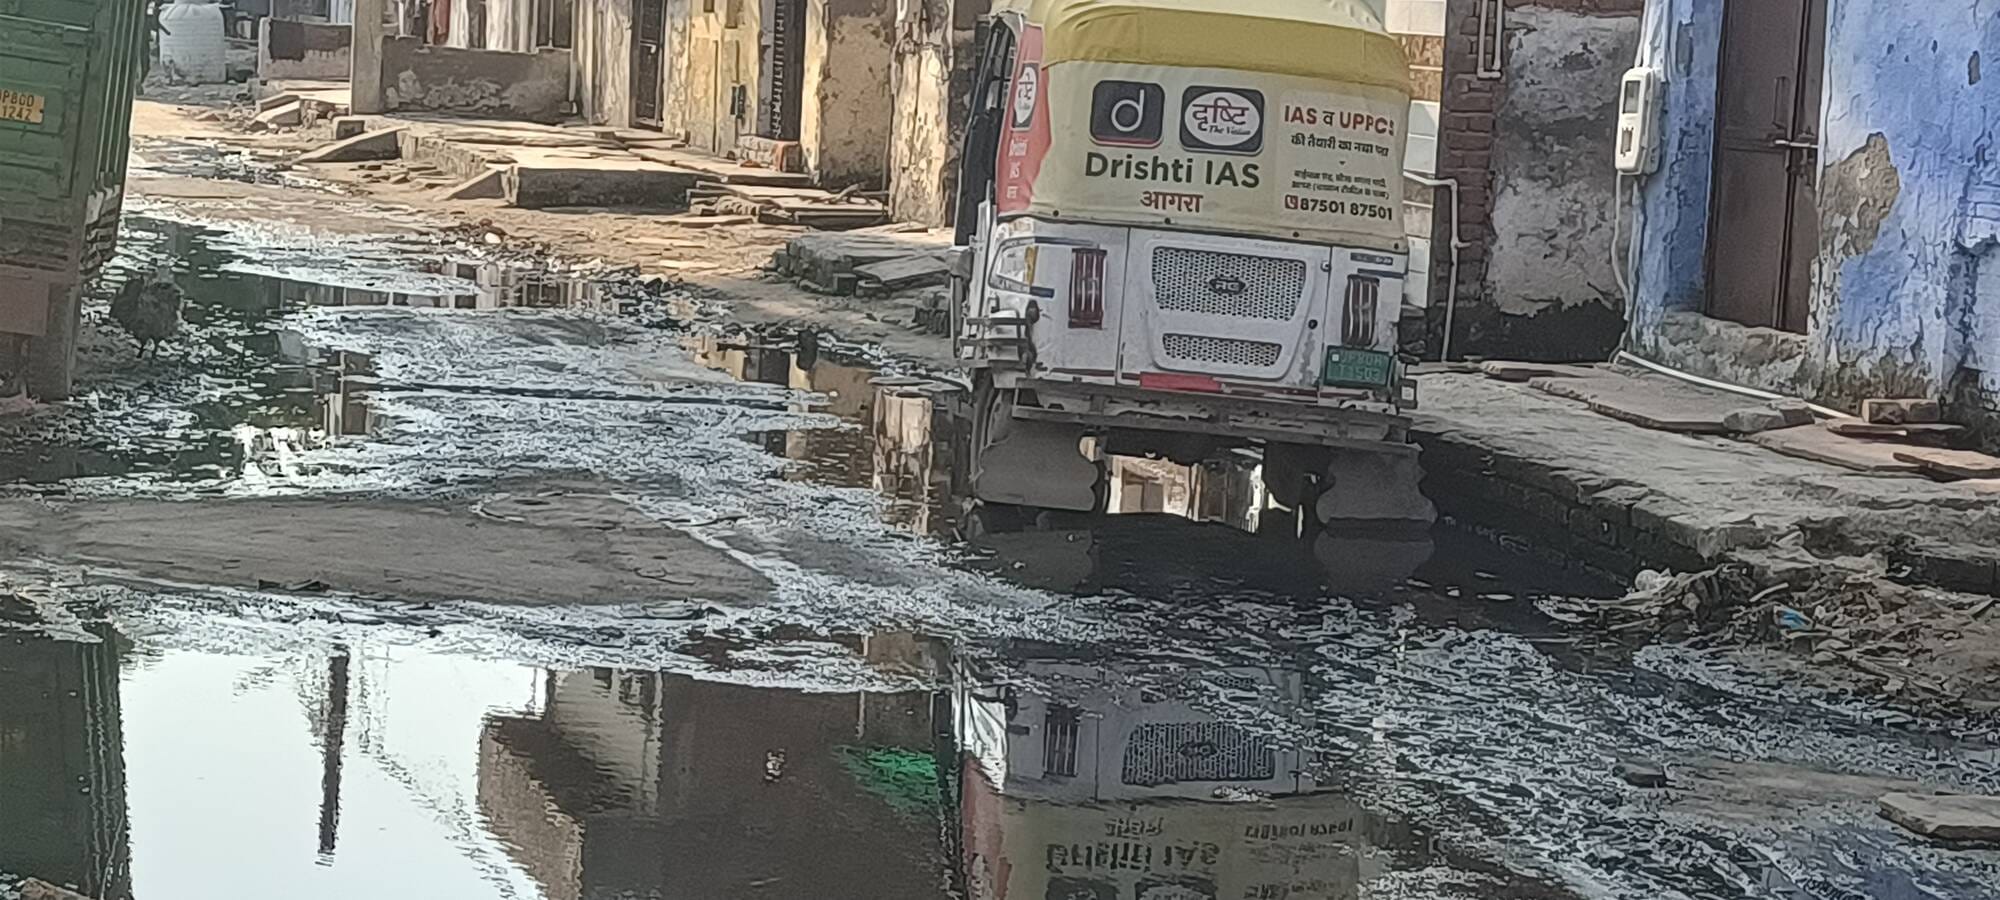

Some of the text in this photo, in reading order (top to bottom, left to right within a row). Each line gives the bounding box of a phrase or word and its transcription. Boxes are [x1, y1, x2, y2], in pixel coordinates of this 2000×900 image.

[1284, 105, 1318, 125] IAS
[1322, 110, 1335, 126] व
[1085, 152, 1193, 183] Drishti
[1206, 160, 1260, 188] IAS
[1140, 191, 1204, 213] आगरा
[1300, 198, 1393, 221] 87501 87501
